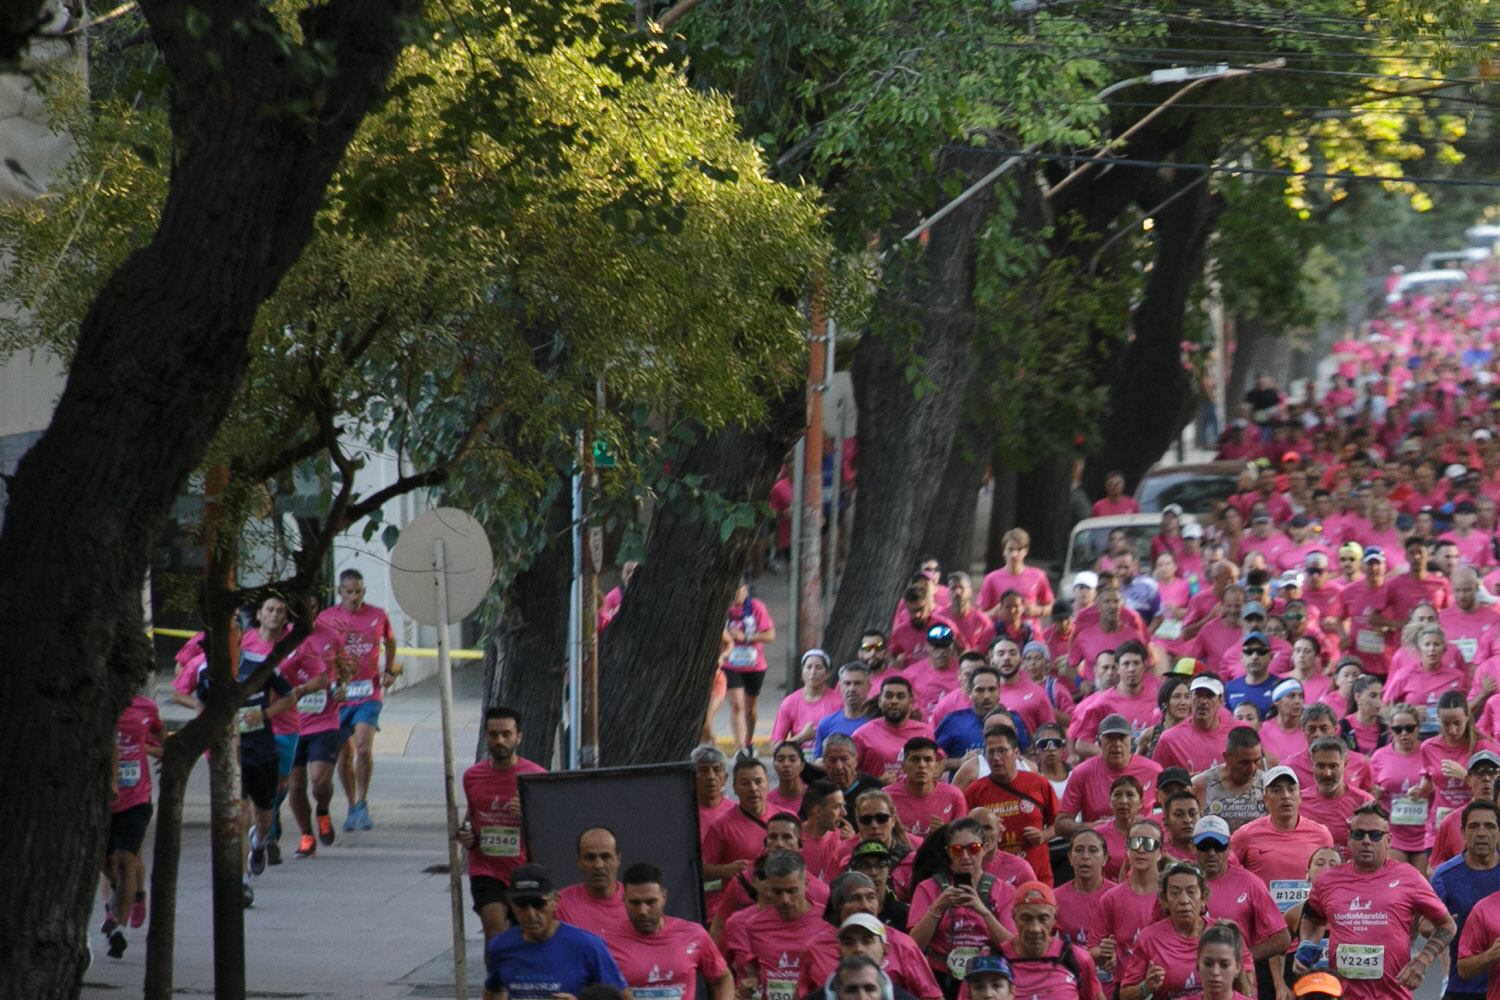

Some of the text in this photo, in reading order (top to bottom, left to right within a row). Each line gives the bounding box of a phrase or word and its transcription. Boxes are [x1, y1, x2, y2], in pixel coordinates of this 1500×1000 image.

[1276, 890, 1309, 900] #1283
[1334, 912, 1388, 921] MediaMaratón
[1340, 956, 1379, 966] Y2243
